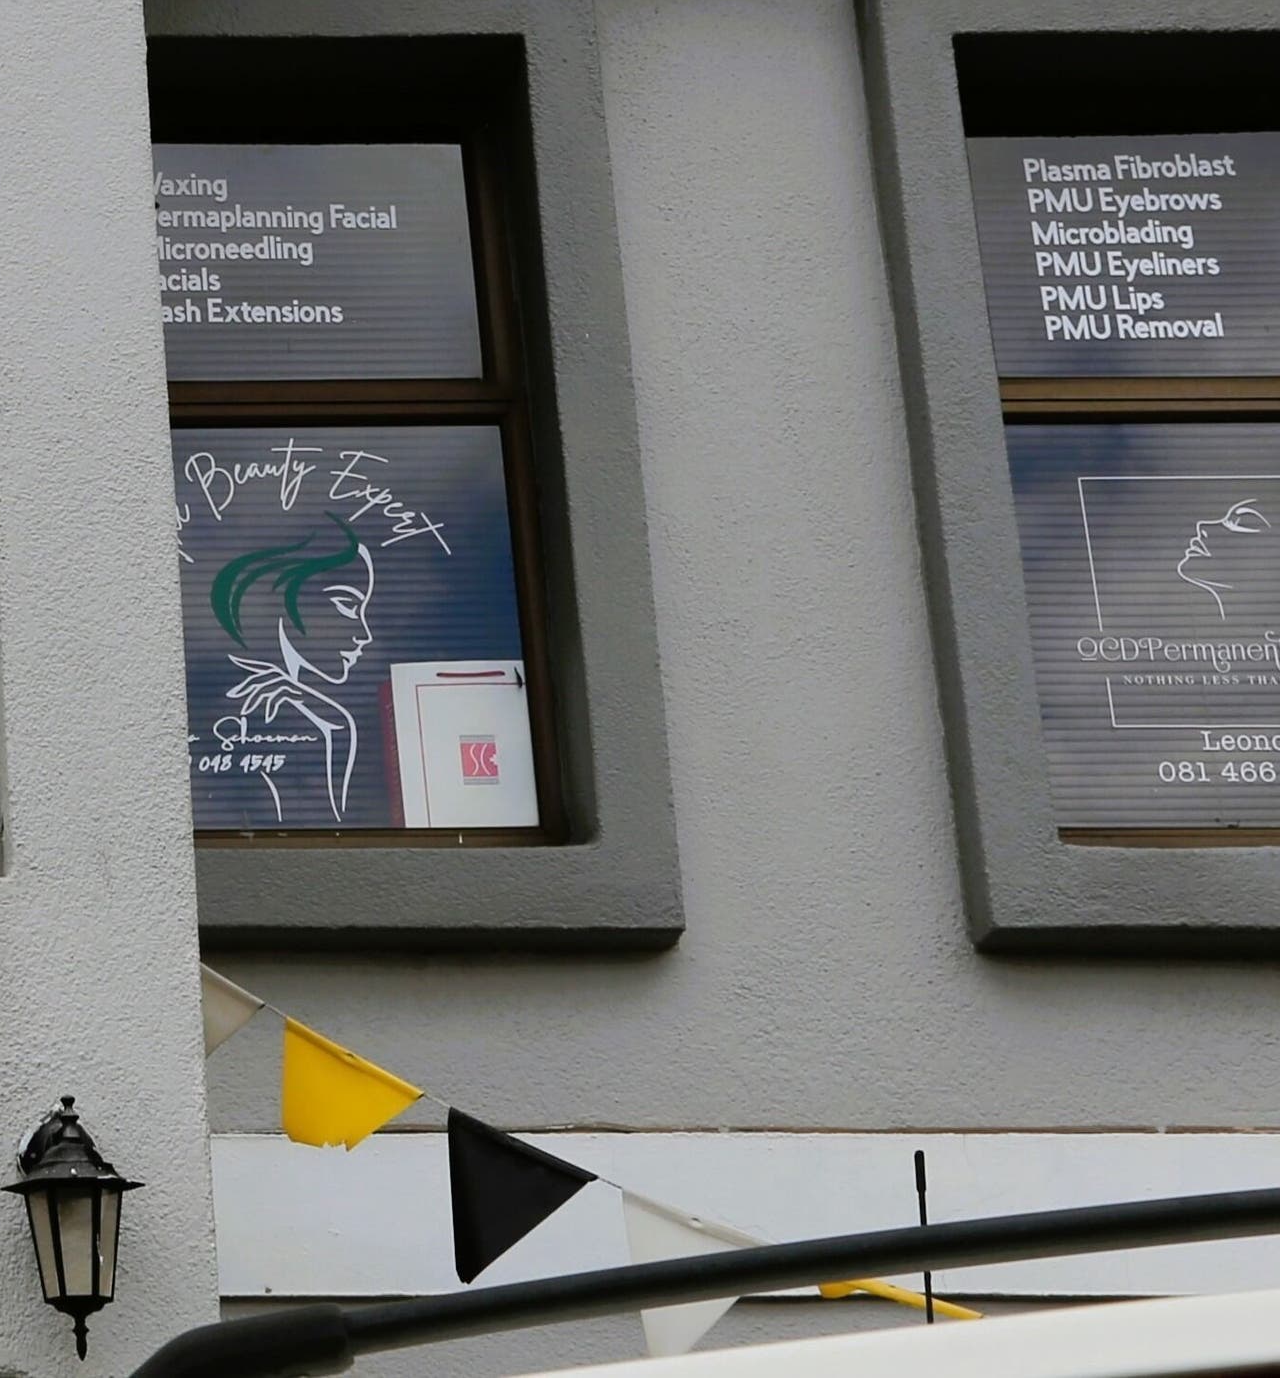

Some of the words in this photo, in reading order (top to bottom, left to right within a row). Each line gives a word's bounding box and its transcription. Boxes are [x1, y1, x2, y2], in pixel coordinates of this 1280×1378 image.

[1023, 157, 1112, 183] Plasma
[1114, 153, 1237, 180] Fibroblast
[330, 204, 397, 230] Facial
[1027, 188, 1094, 214] PMU
[1098, 187, 1223, 218] Eyebrows
[1031, 220, 1195, 250] Microblading
[1035, 251, 1102, 277] PMU
[1106, 251, 1221, 282] Eyeliners
[207, 297, 344, 323] Extensions
[1040, 285, 1107, 311] PMU
[1111, 285, 1165, 315] Lips
[1044, 314, 1113, 340] PMU
[1115, 312, 1225, 340] Removal
[184, 438, 323, 521] Beauty
[329, 450, 451, 556] Expert
[1123, 675, 1195, 686] NOTHING
[1203, 675, 1240, 686] LESS
[213, 716, 318, 751] Schoeman
[1158, 761, 1211, 782] 081
[1221, 761, 1277, 782] 466
